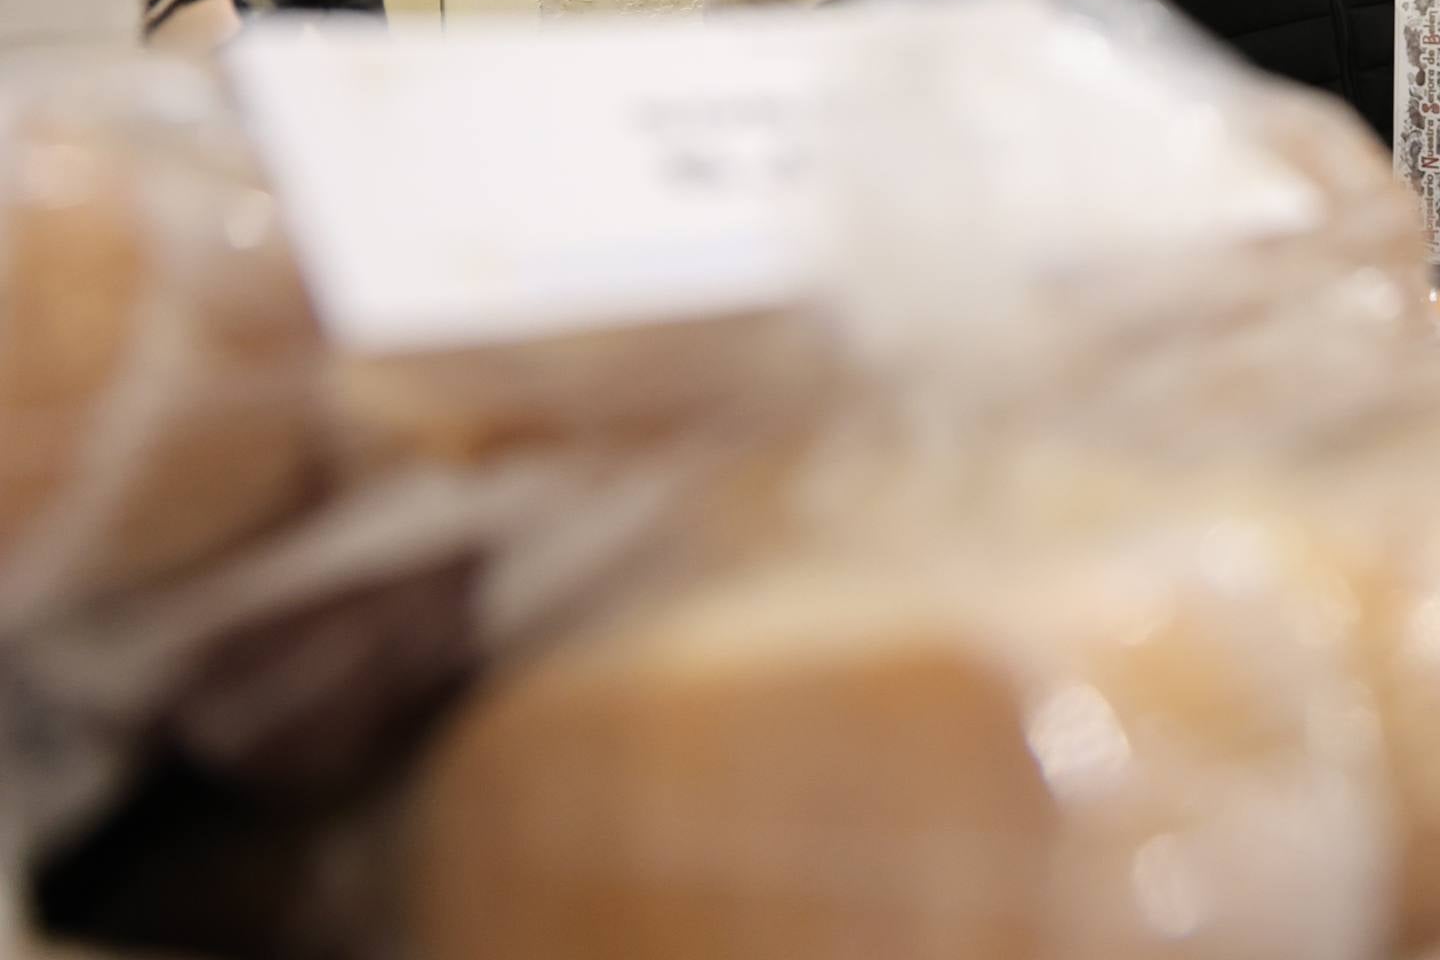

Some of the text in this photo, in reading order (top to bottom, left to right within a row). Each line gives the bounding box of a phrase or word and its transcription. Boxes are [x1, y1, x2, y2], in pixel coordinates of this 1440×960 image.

[1422, 49, 1435, 65] de
[1421, 69, 1440, 114] Señora
[1421, 120, 1440, 169] Nuestra
